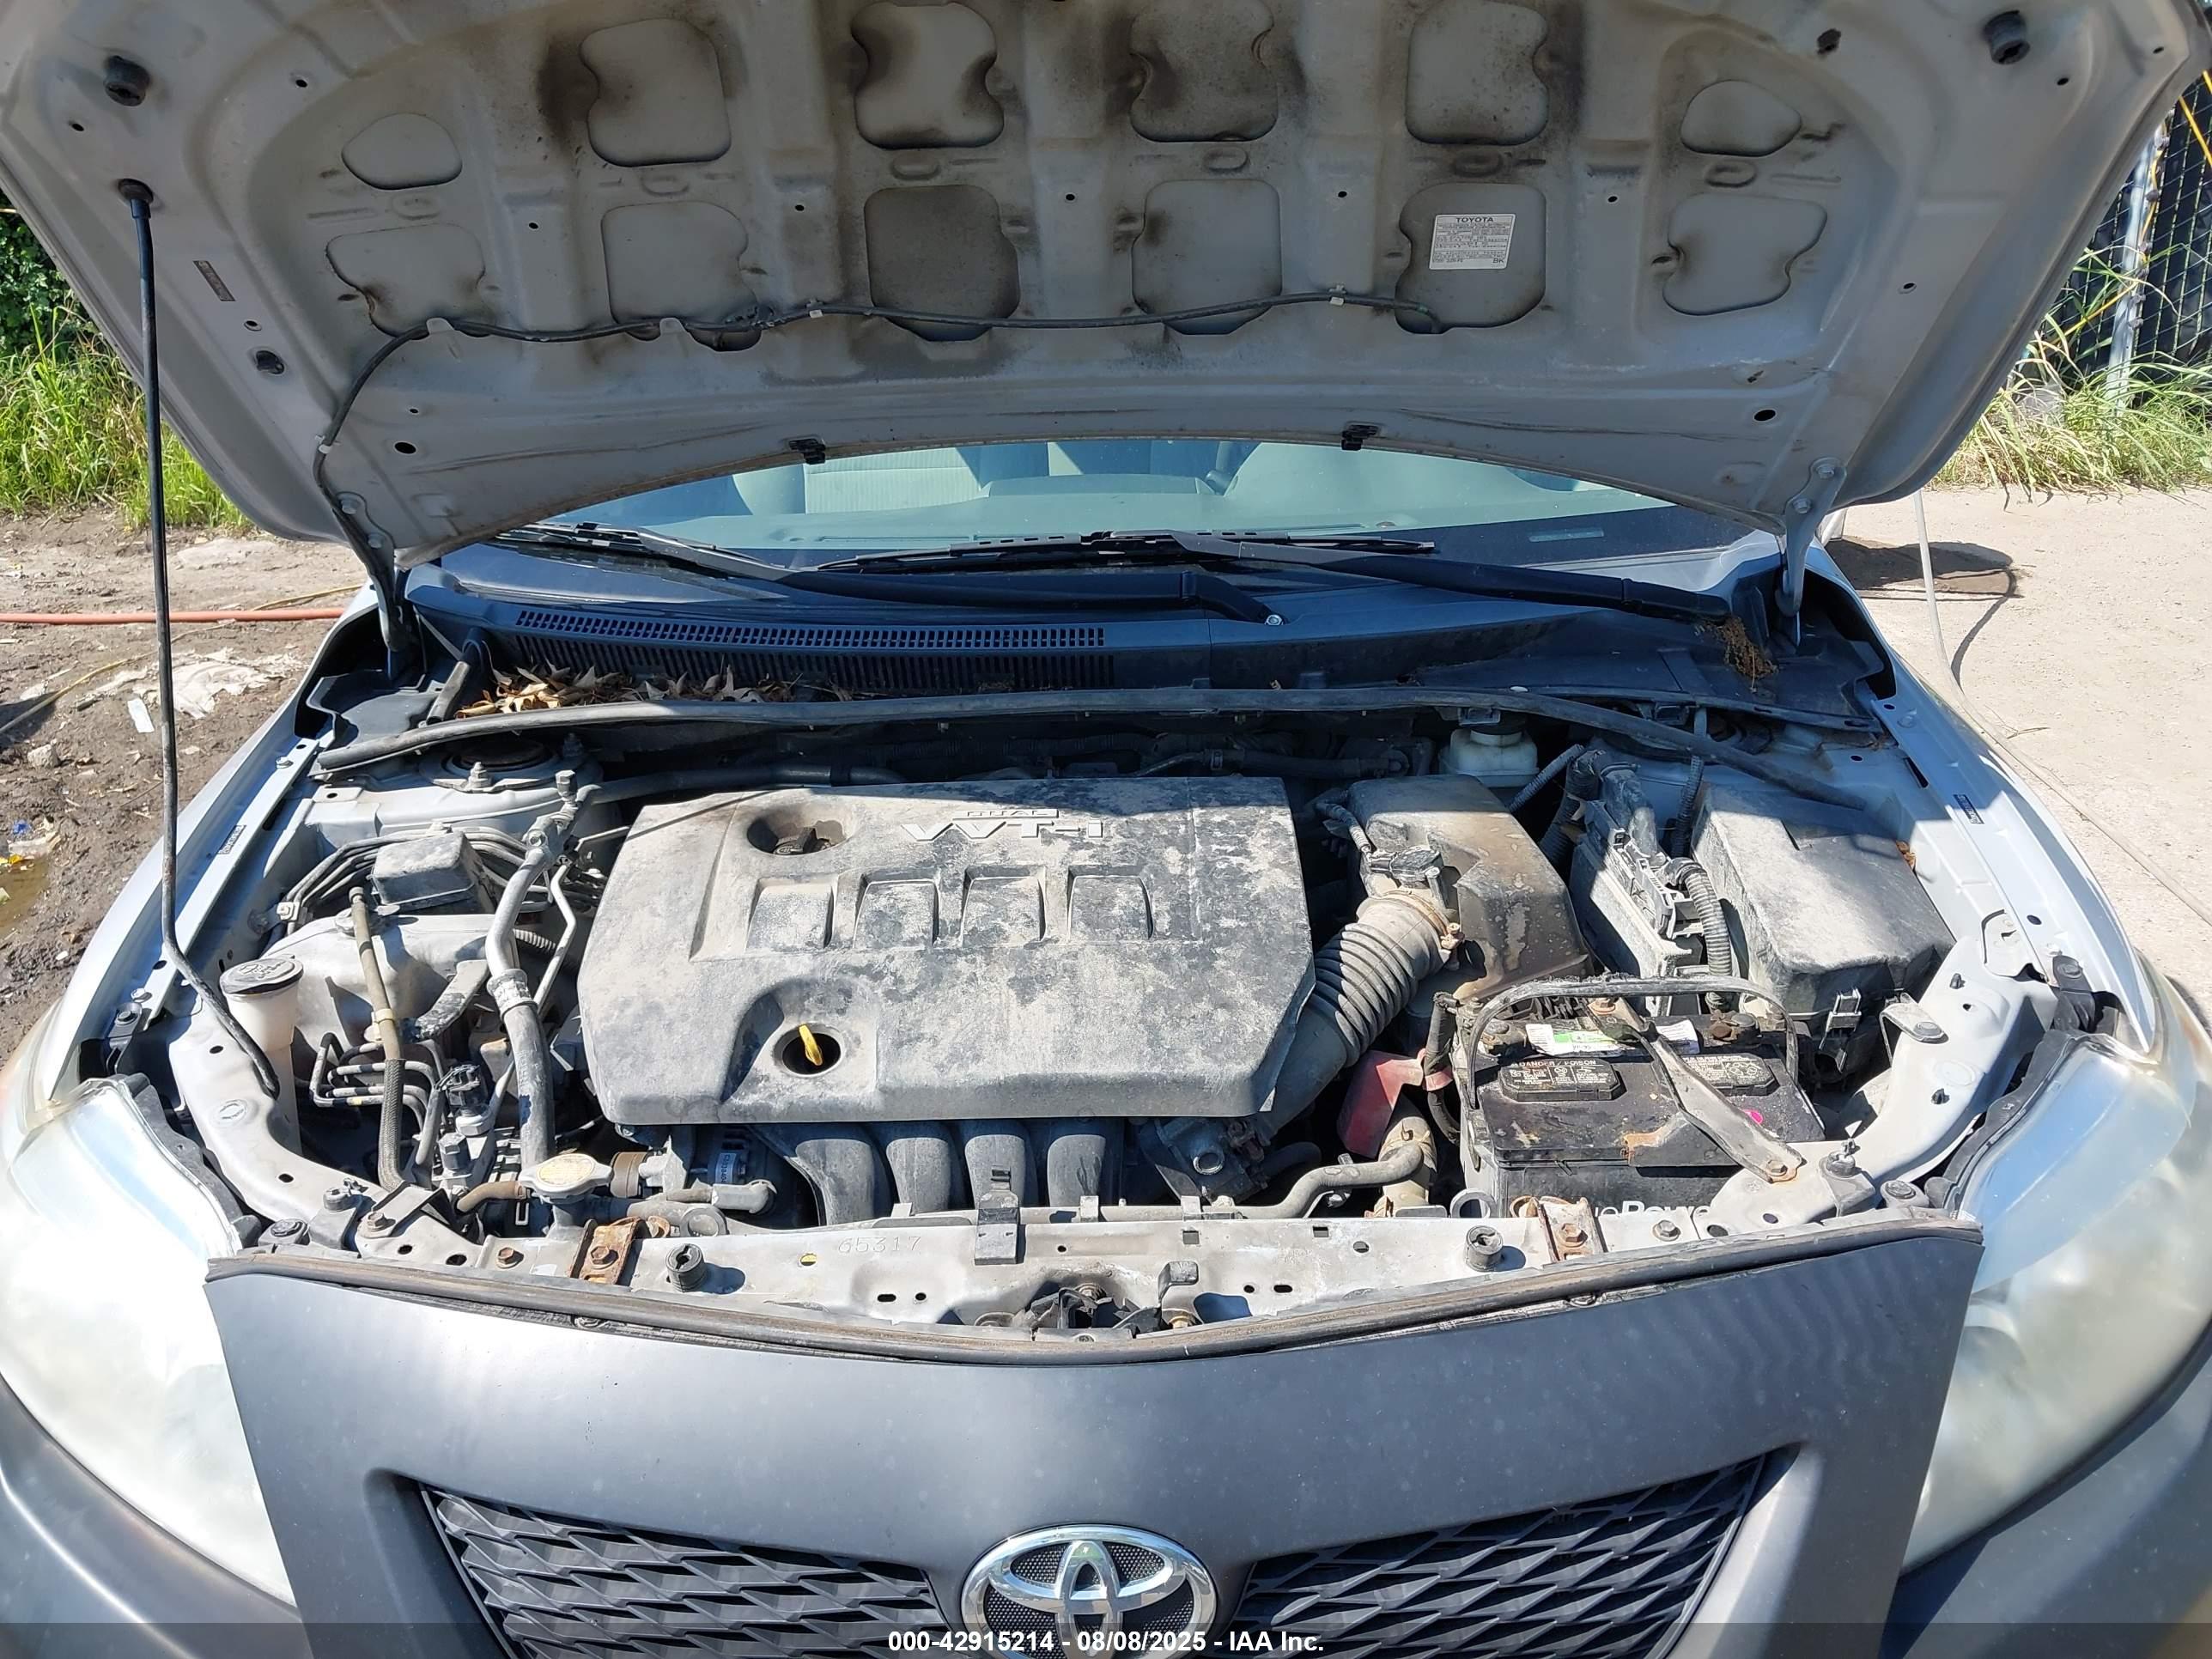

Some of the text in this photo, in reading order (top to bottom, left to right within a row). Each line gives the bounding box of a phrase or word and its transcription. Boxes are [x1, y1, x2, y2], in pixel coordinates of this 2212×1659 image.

[965, 810, 1049, 818] DUAL
[901, 820, 1104, 842] VVT-i
[838, 1236, 921, 1253] 65317
